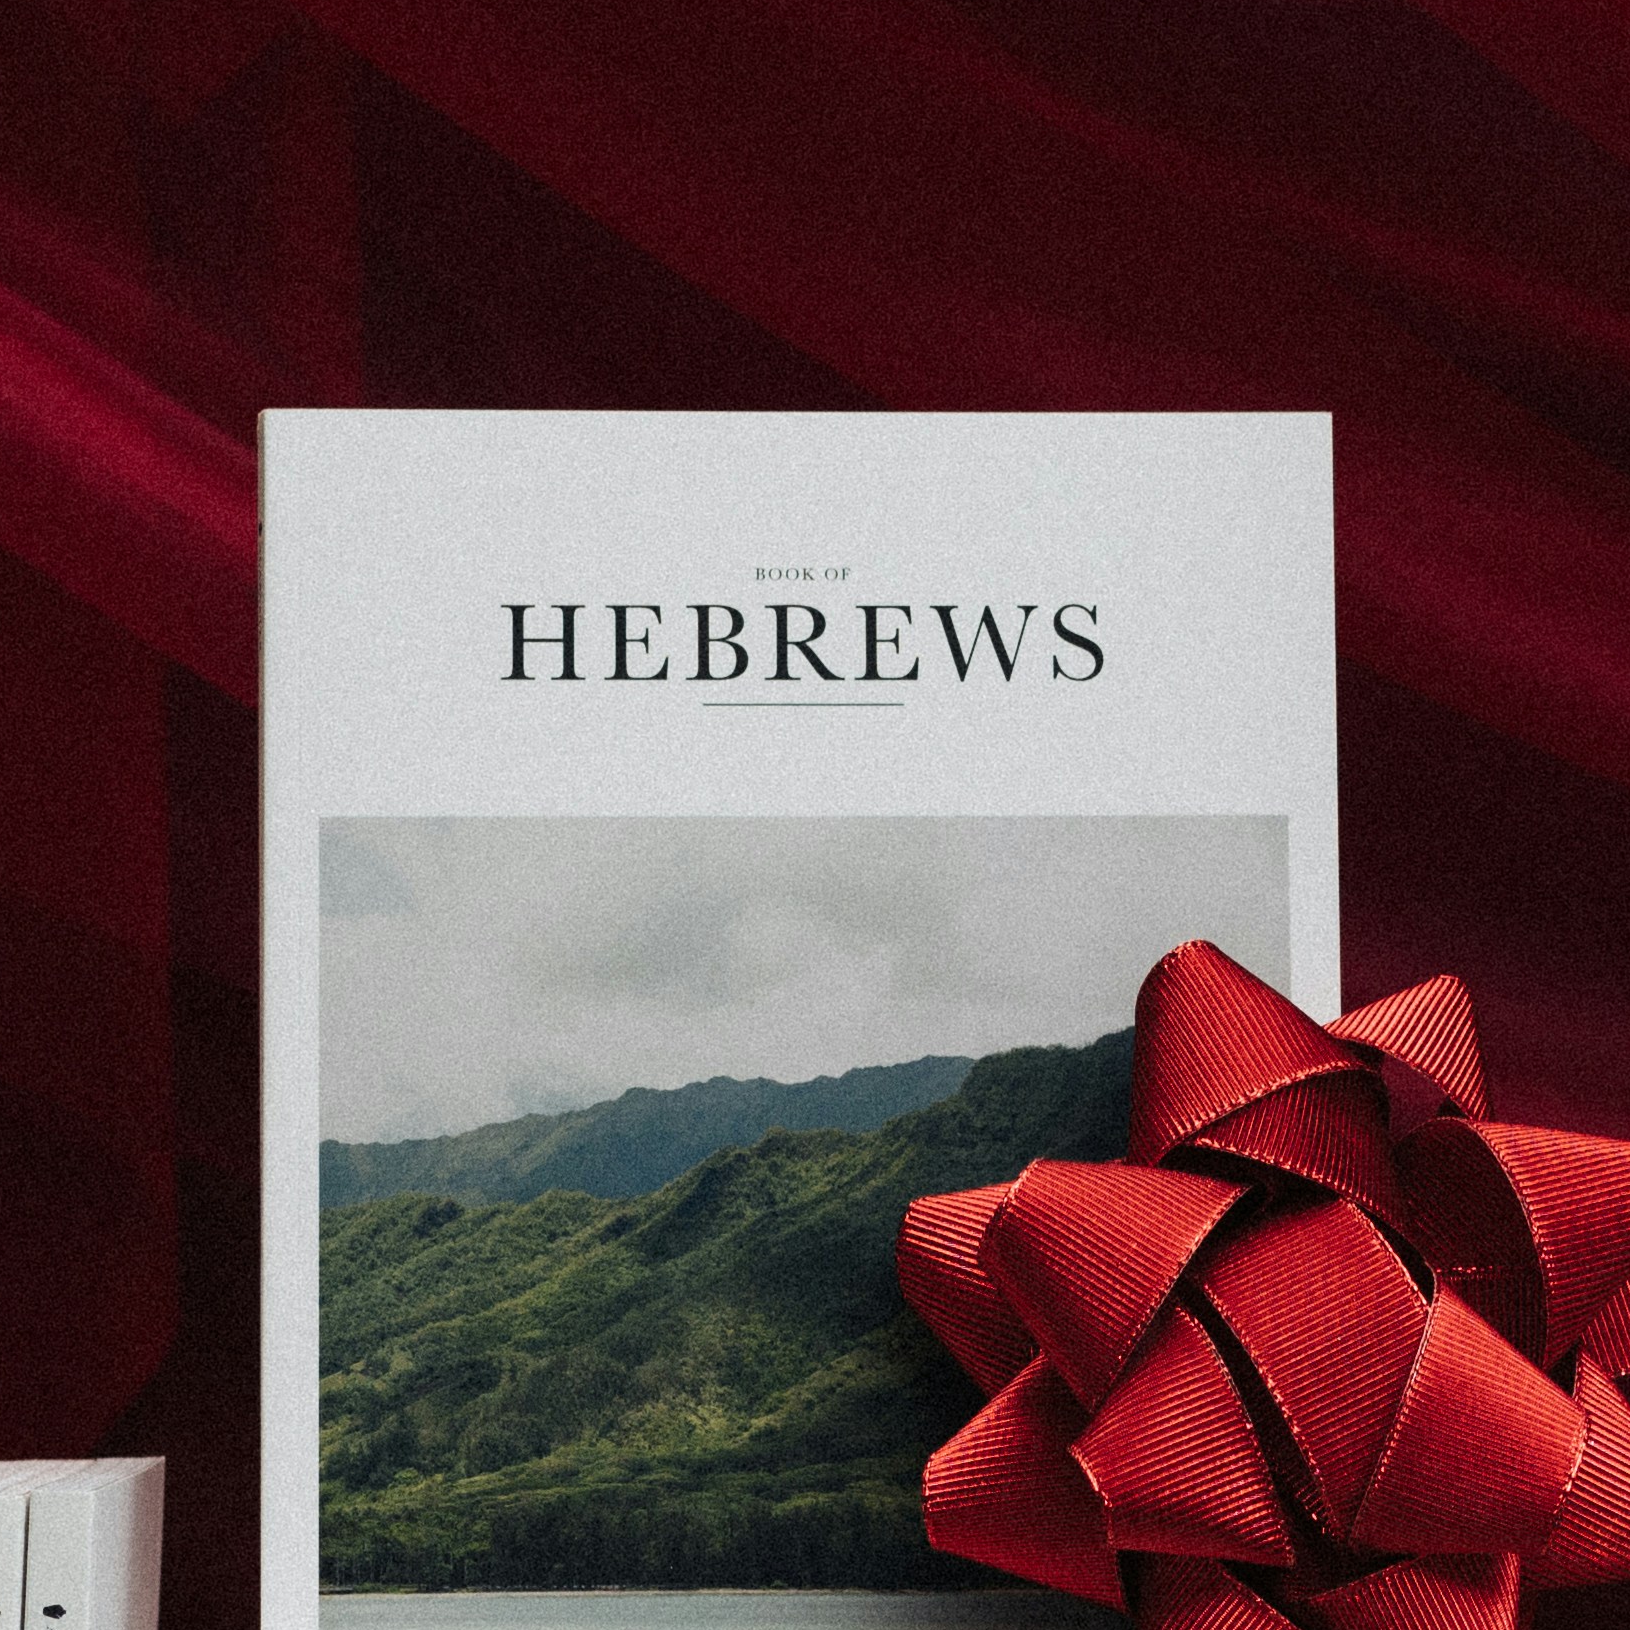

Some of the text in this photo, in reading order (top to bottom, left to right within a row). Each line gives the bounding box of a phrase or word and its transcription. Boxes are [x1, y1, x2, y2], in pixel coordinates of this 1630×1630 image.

[755, 566, 851, 582] BOOK OF
[500, 603, 1105, 683] HEBREWS
